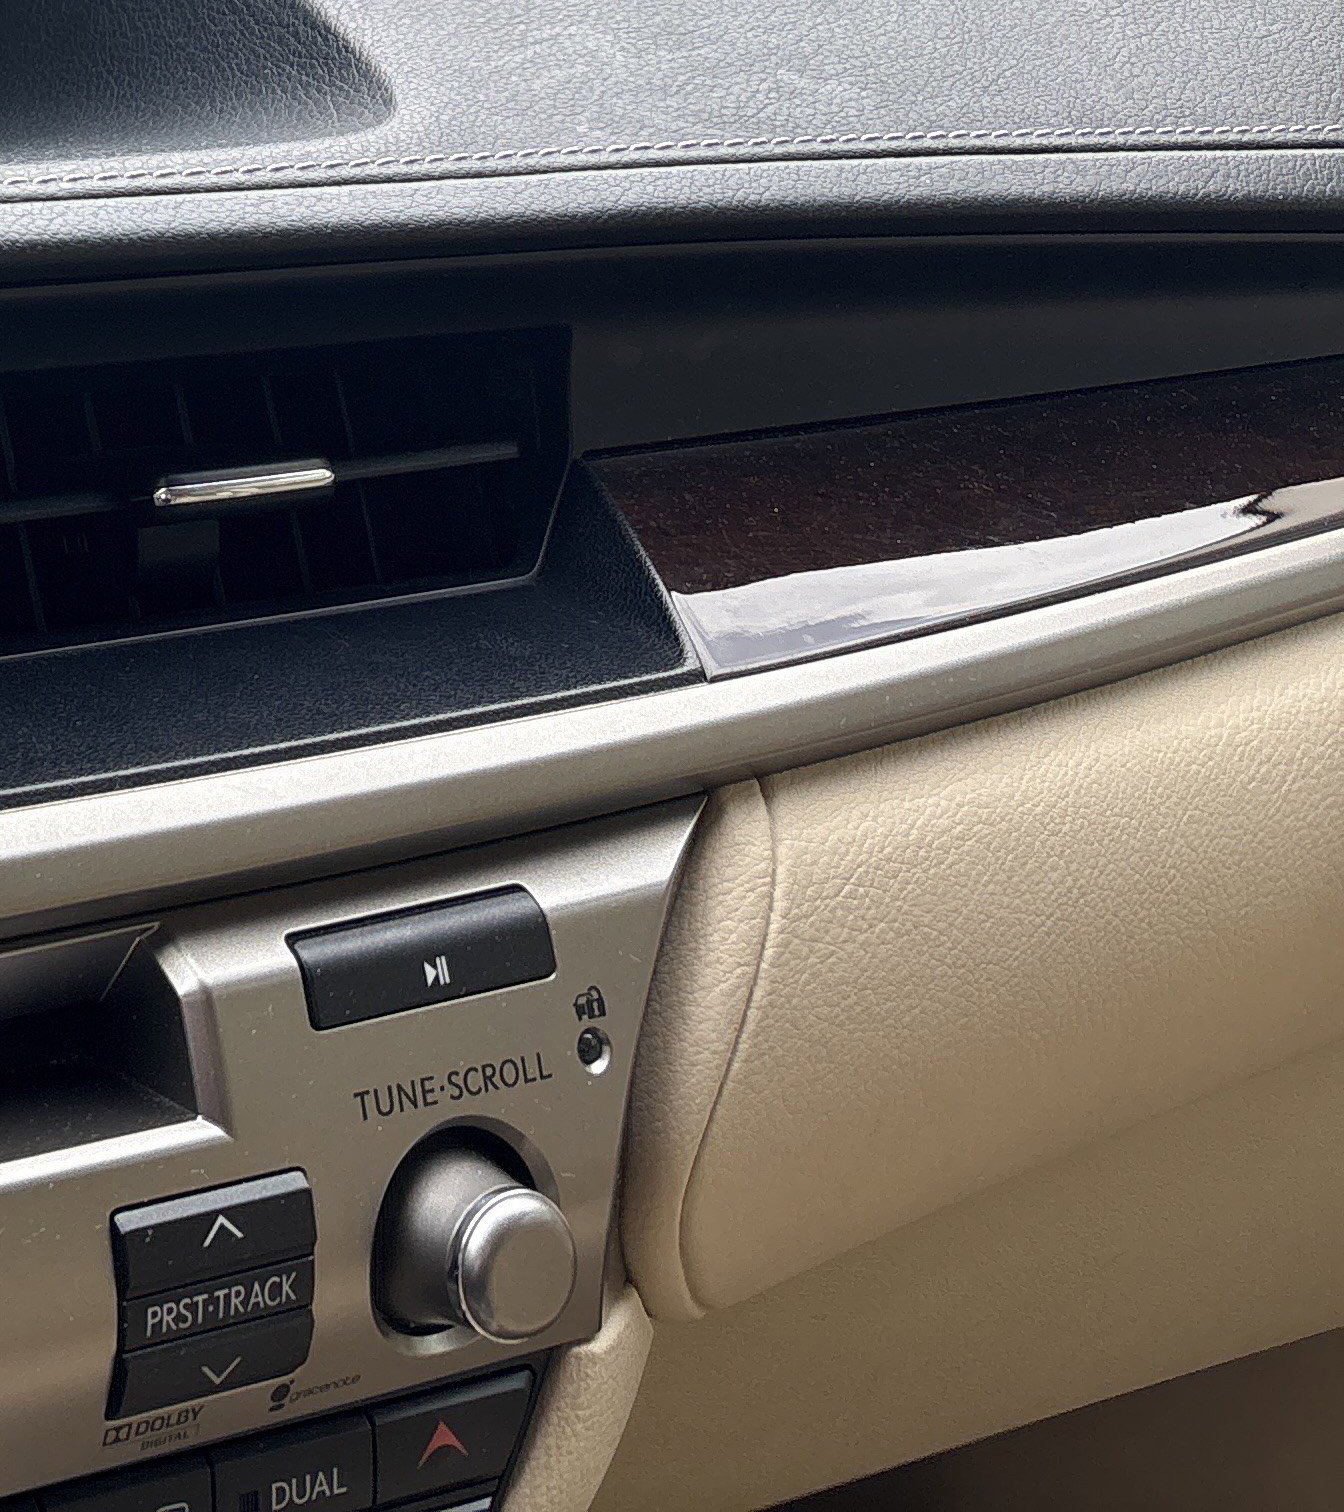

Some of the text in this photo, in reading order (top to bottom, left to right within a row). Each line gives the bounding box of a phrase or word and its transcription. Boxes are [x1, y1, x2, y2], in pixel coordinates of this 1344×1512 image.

[134, 1403, 205, 1436] DOLBY
[139, 1430, 191, 1451] DIGITAL
[270, 1467, 348, 1512] DUAL
